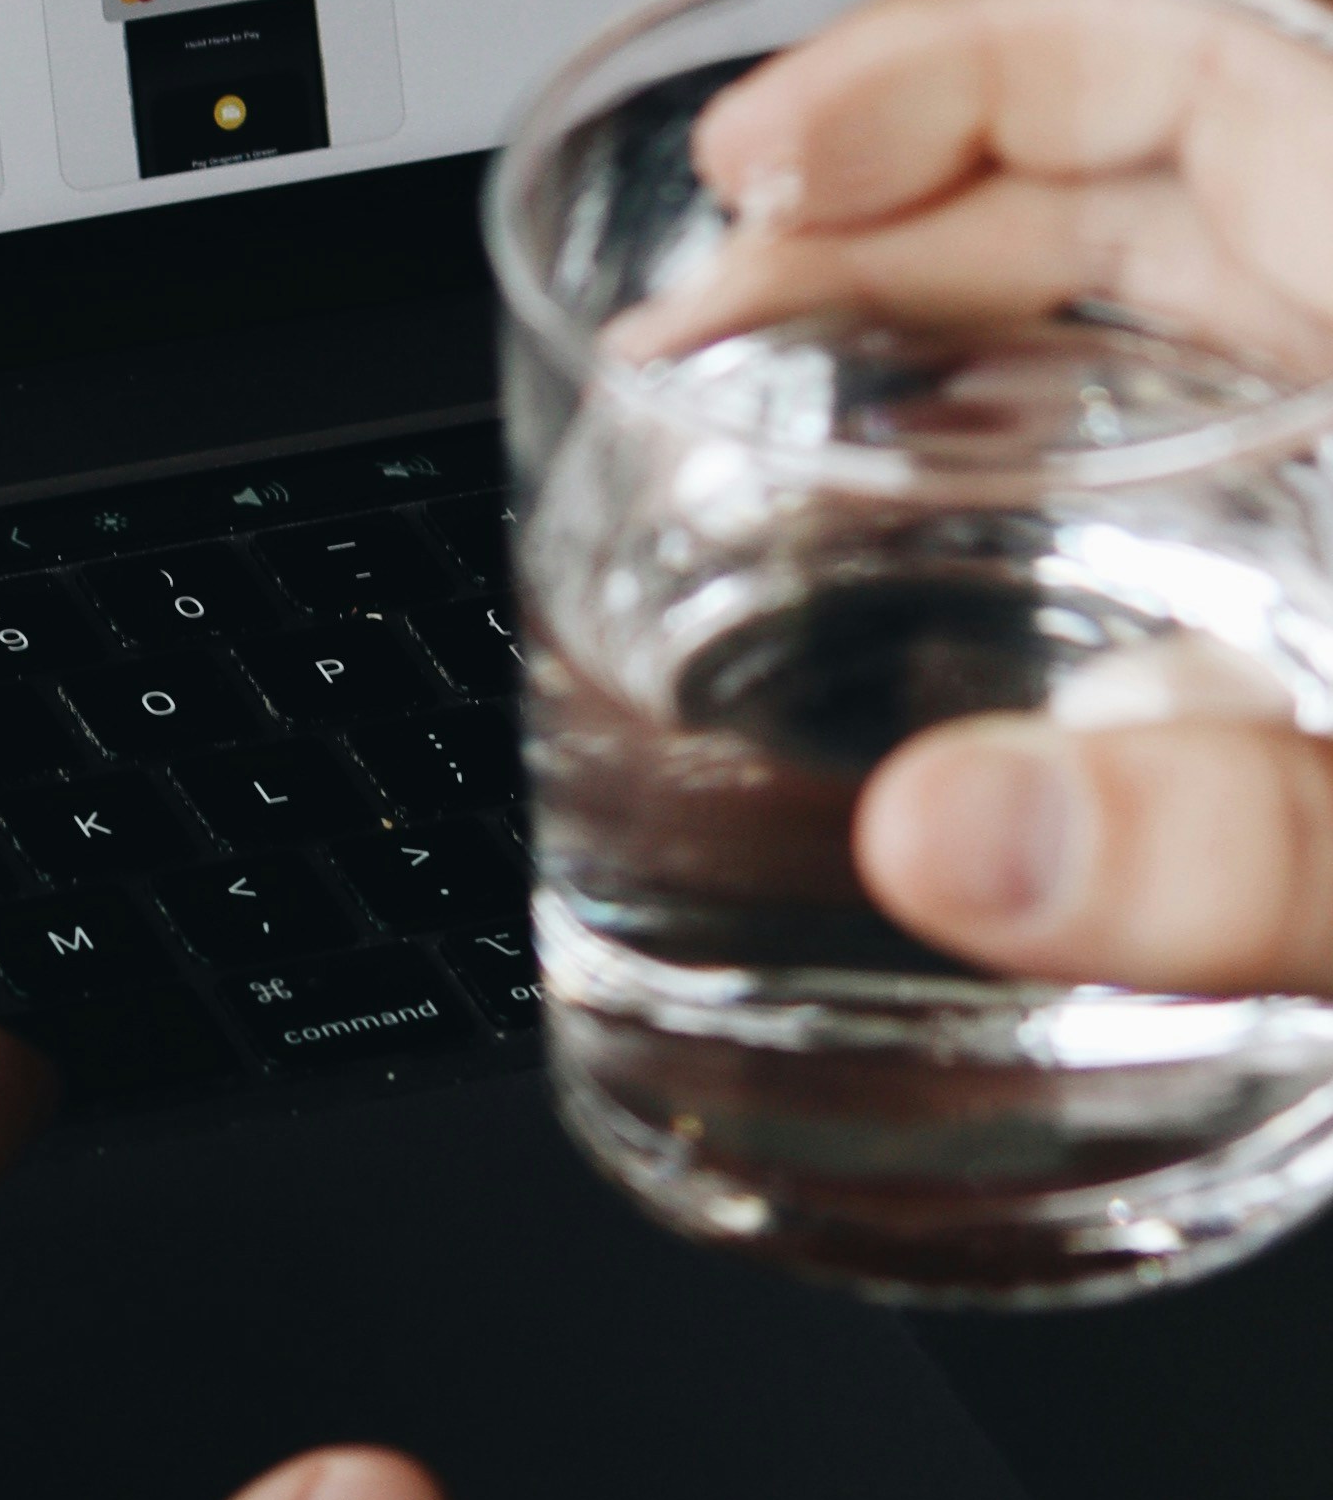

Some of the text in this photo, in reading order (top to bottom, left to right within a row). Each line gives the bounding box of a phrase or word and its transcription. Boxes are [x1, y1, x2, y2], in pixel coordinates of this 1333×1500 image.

[175, 597, 204, 617] 0
[316, 660, 344, 683] P
[142, 692, 175, 715] O
[254, 782, 287, 803] L
[74, 812, 111, 837] K
[48, 927, 93, 954] M
[285, 1000, 438, 1043] command
